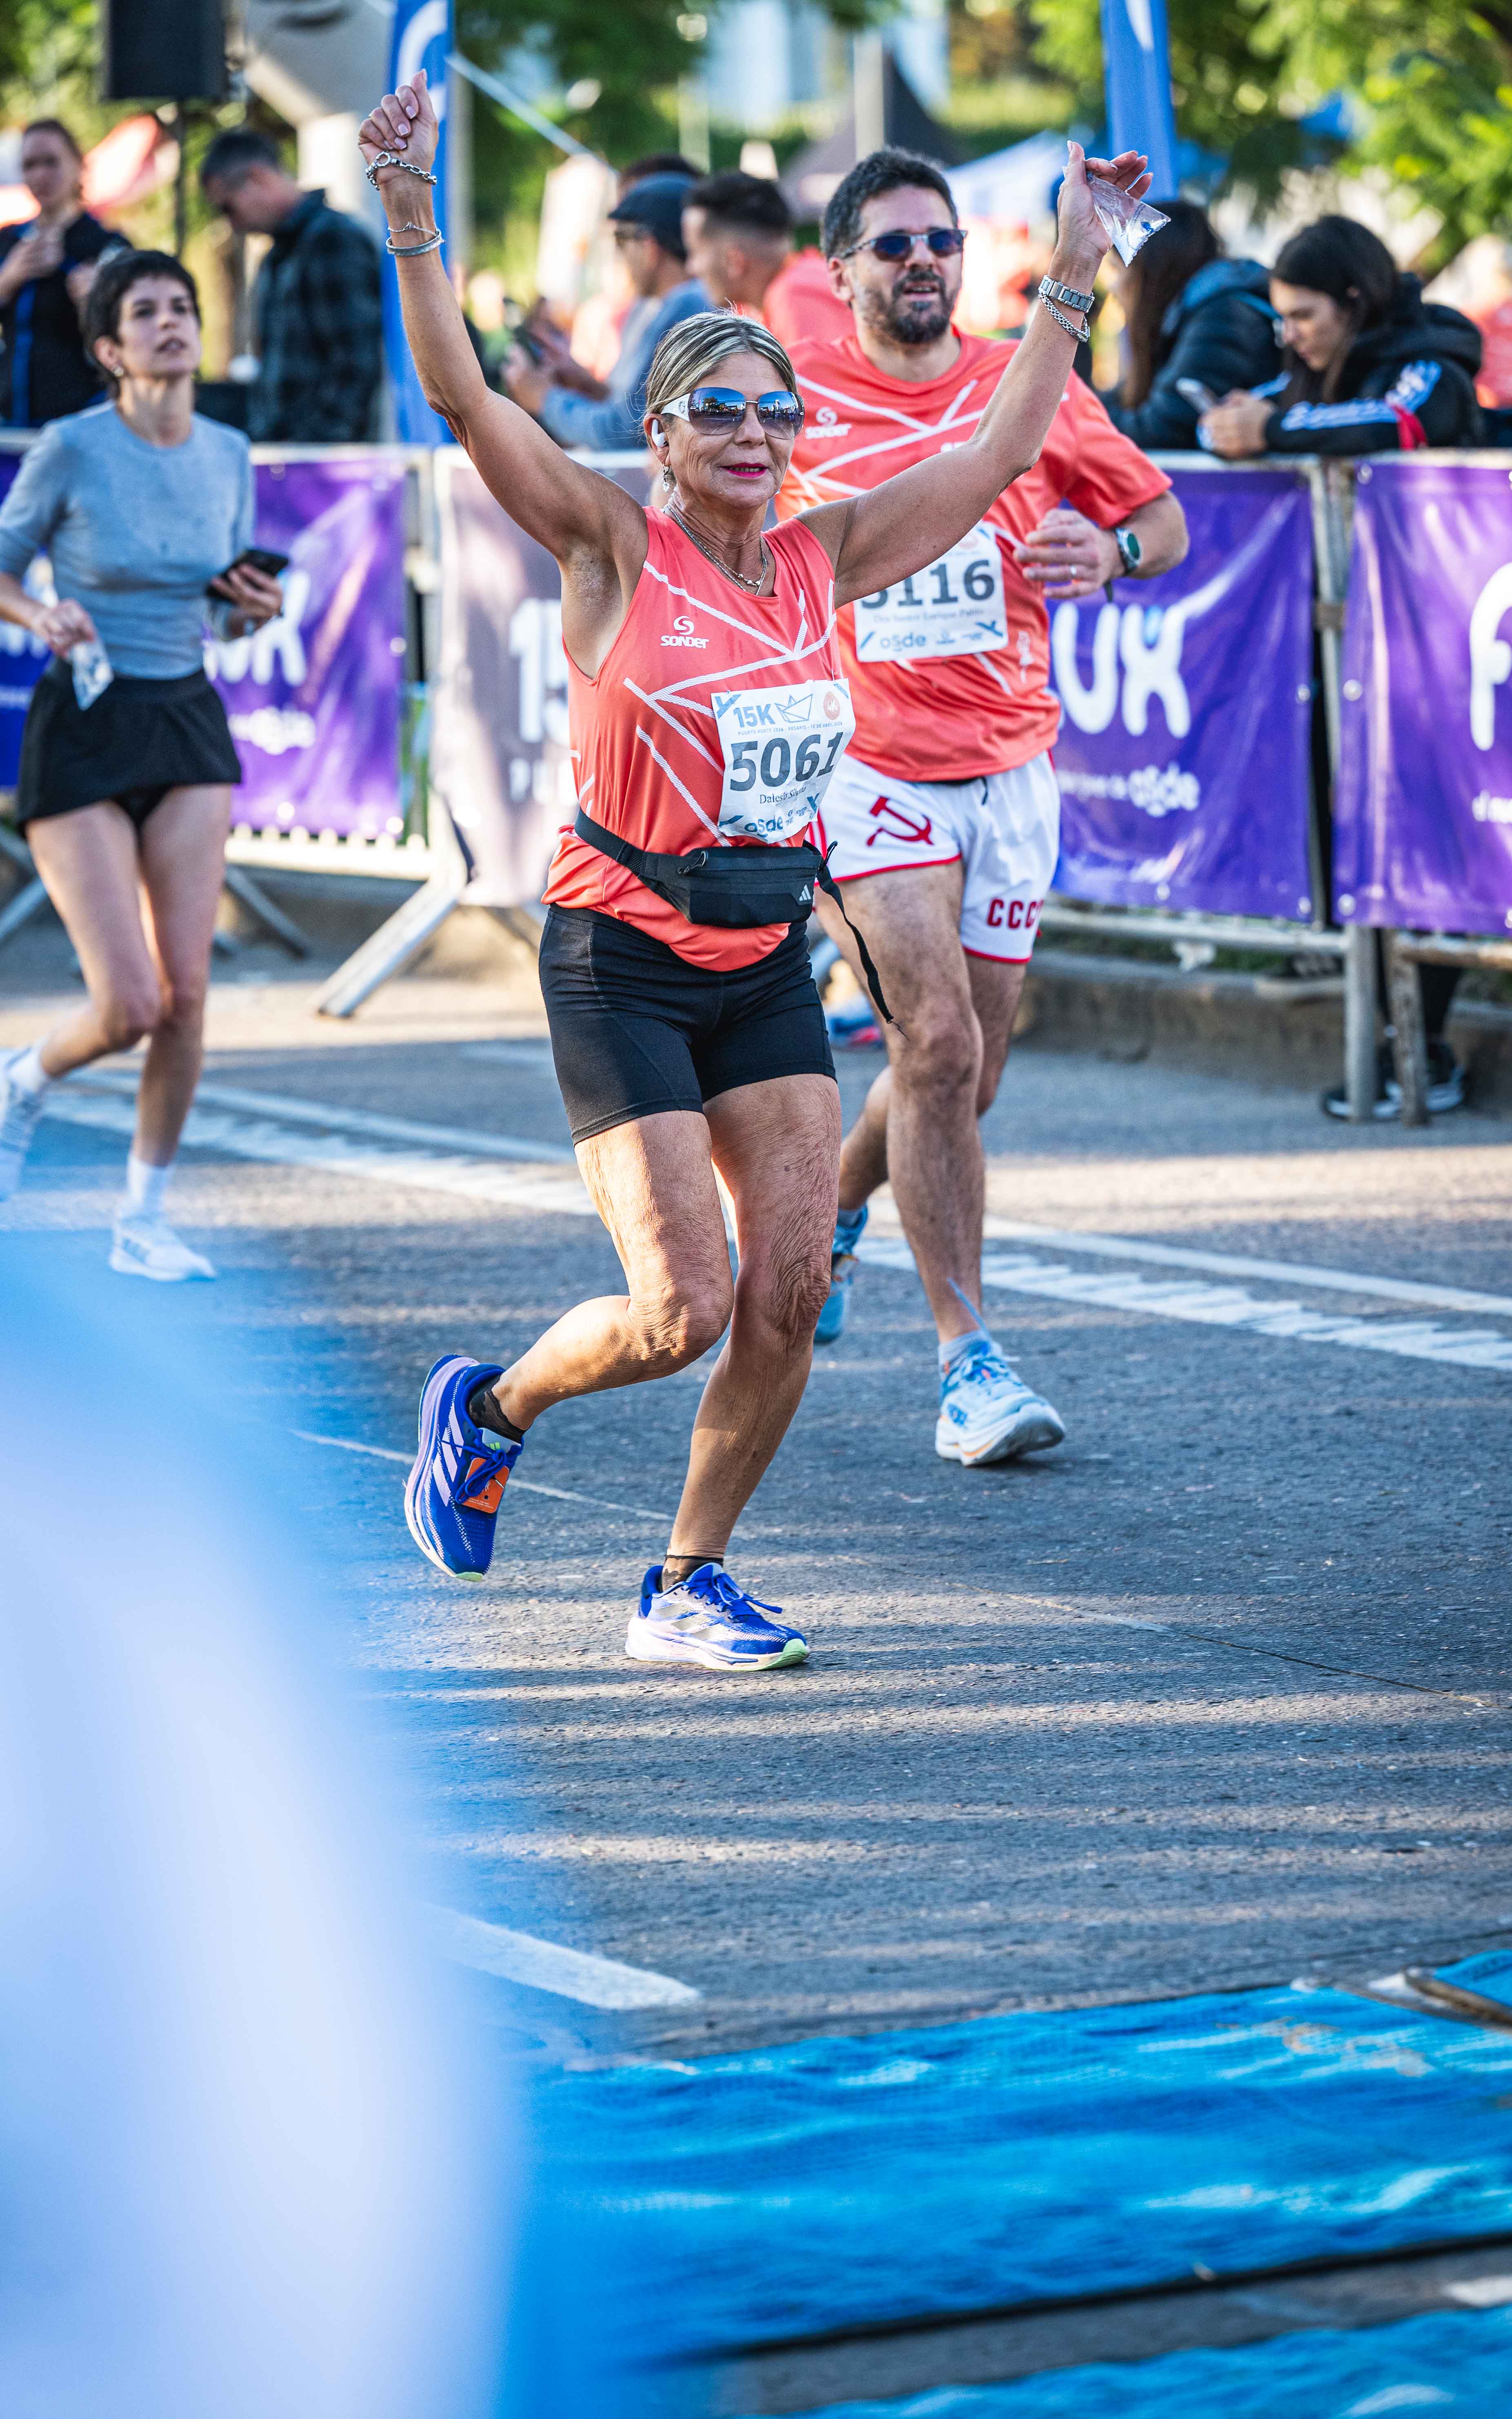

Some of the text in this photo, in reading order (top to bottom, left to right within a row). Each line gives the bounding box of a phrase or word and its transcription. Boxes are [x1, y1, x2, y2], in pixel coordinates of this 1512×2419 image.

[1052, 601, 1191, 738] UX
[733, 704, 775, 728] 15K
[730, 732, 844, 792] 5061
[759, 792, 788, 804] Dalesio
[744, 815, 783, 836] osde
[986, 898, 1044, 929] CCC
